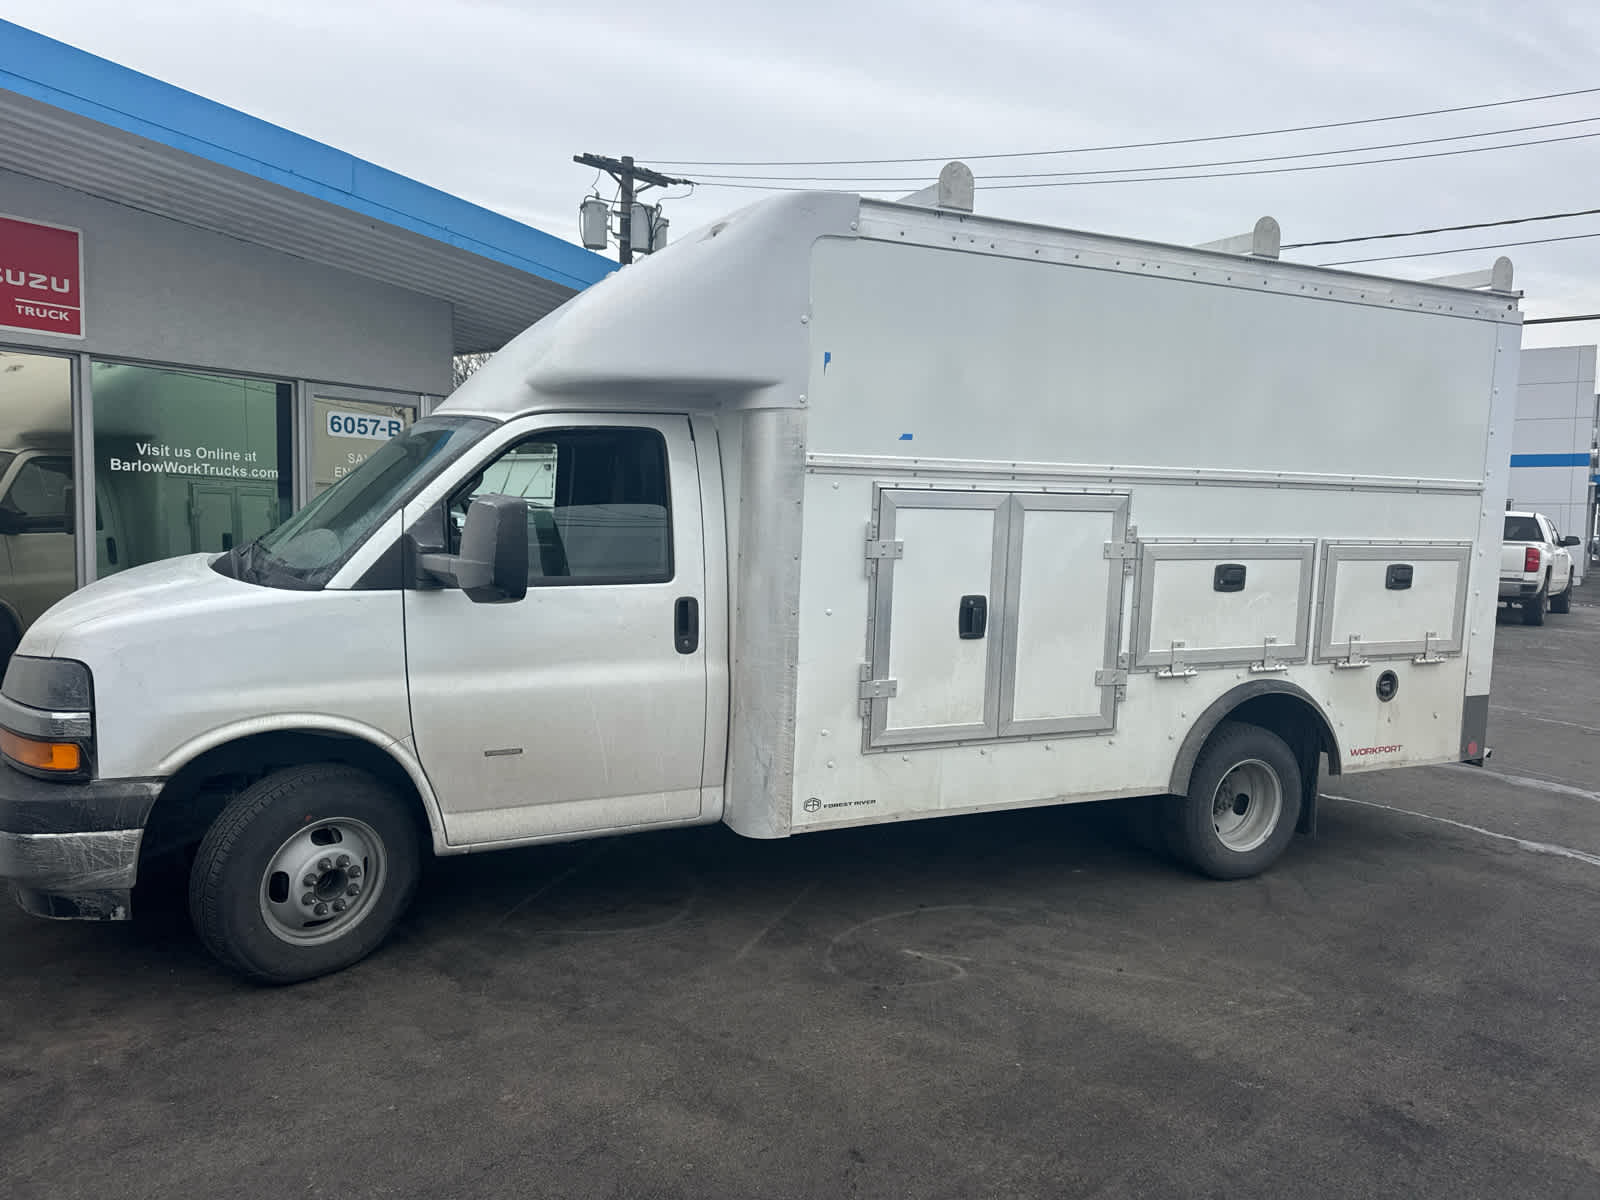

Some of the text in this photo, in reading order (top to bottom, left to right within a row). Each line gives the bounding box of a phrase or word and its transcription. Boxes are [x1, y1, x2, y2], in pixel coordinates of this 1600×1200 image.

[0, 268, 70, 293] UZU
[15, 304, 70, 321] TRUCK
[330, 415, 401, 437] 6057-B
[136, 443, 257, 462] Visit us Online at
[110, 458, 278, 479] BarlowWorkTrucks.com
[1350, 744, 1403, 757] WORKPORT
[823, 799, 877, 809] FOREST RIVER
